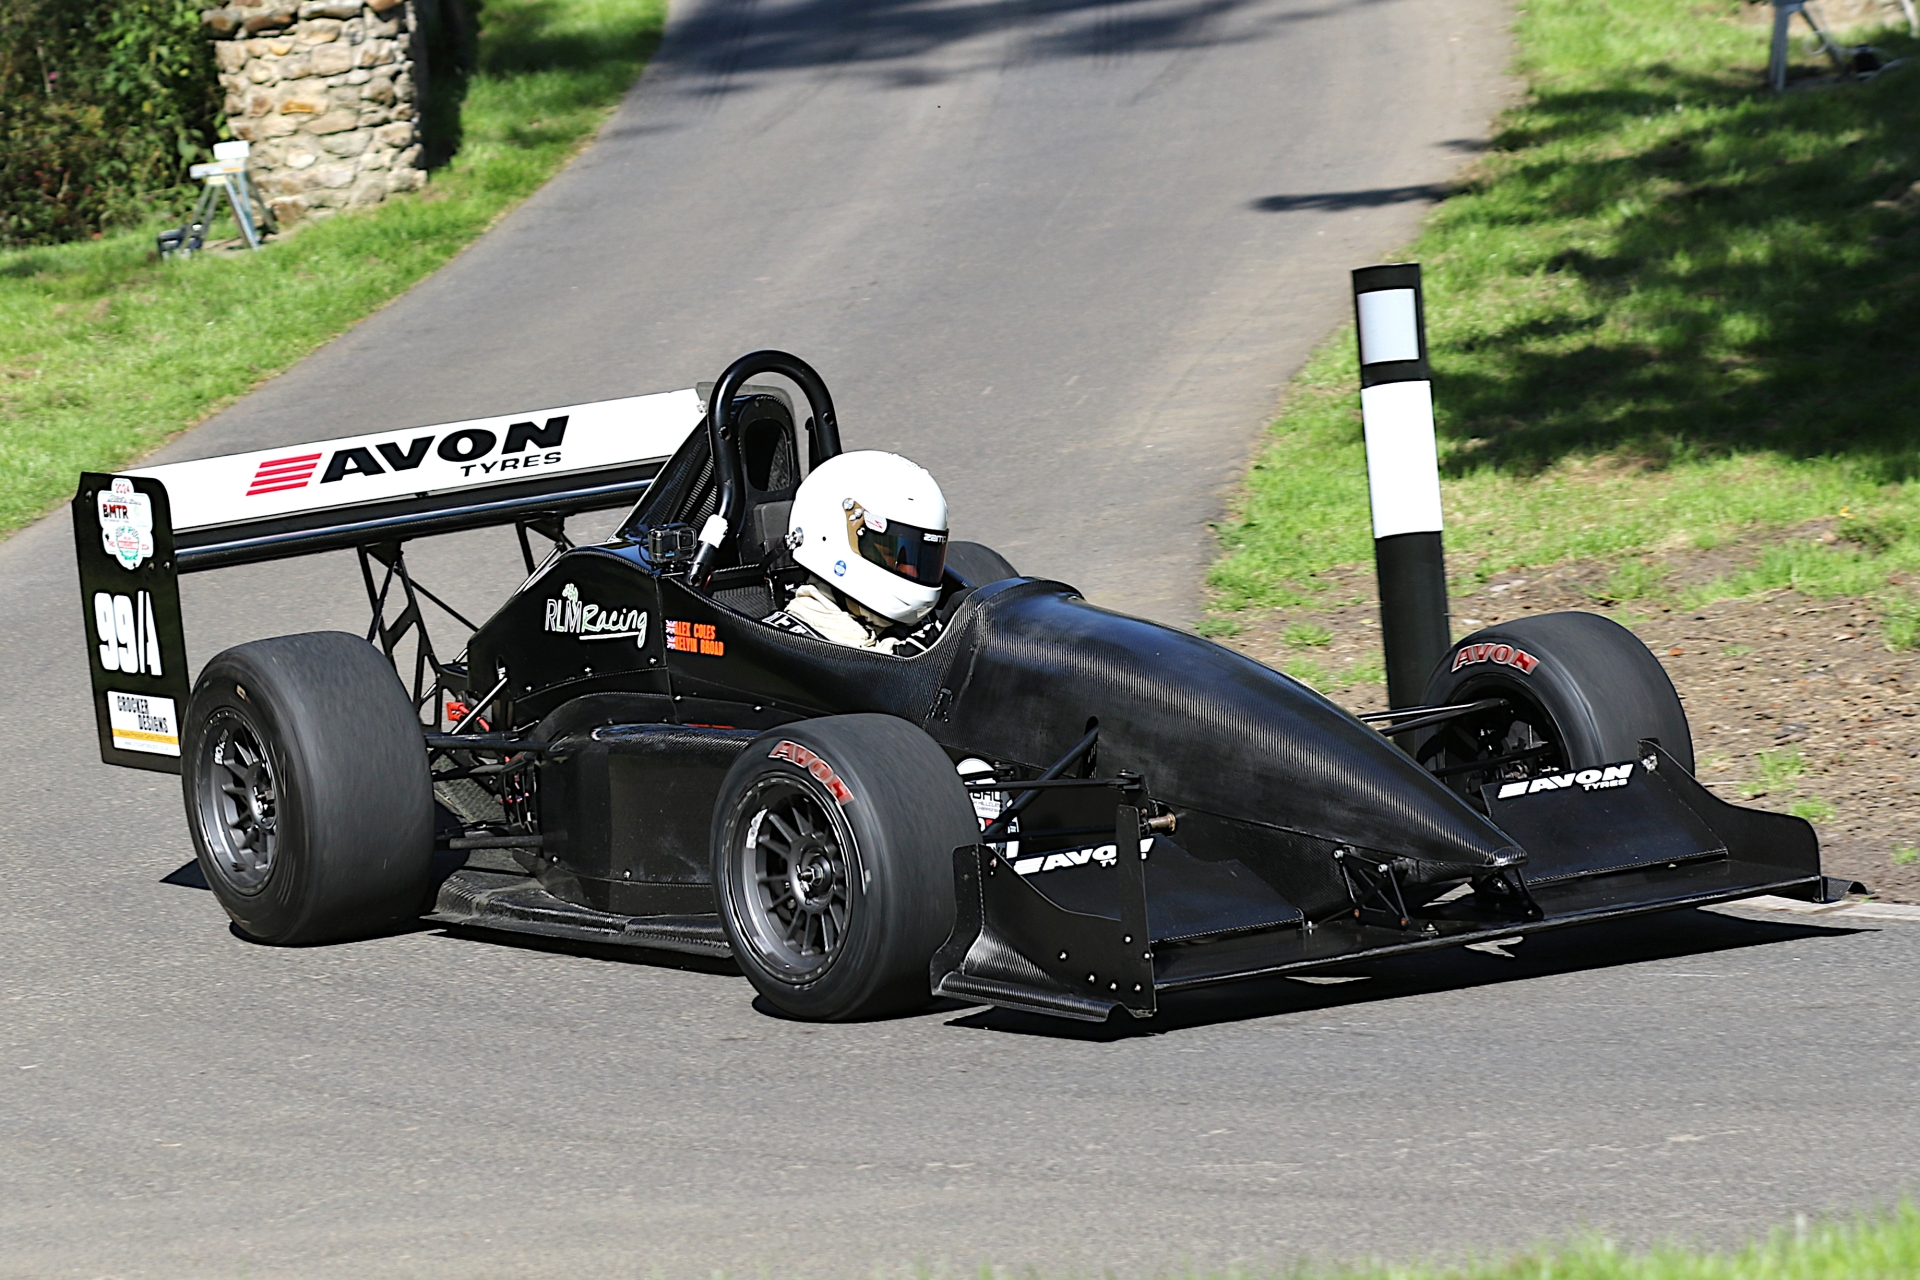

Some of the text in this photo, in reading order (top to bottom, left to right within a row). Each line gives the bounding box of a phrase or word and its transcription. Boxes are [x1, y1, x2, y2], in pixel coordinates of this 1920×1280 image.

[319, 415, 570, 484] AVON
[460, 451, 562, 477] TYRES
[102, 503, 130, 520] BMTR
[674, 621, 716, 640] ALEX COLES
[1451, 643, 1541, 675] AVON
[117, 695, 149, 715] CROCKER
[138, 714, 169, 734] DESIGNS
[767, 740, 855, 806] AVON
[1528, 764, 1634, 793] AVON
[1583, 778, 1628, 791] TYRES
